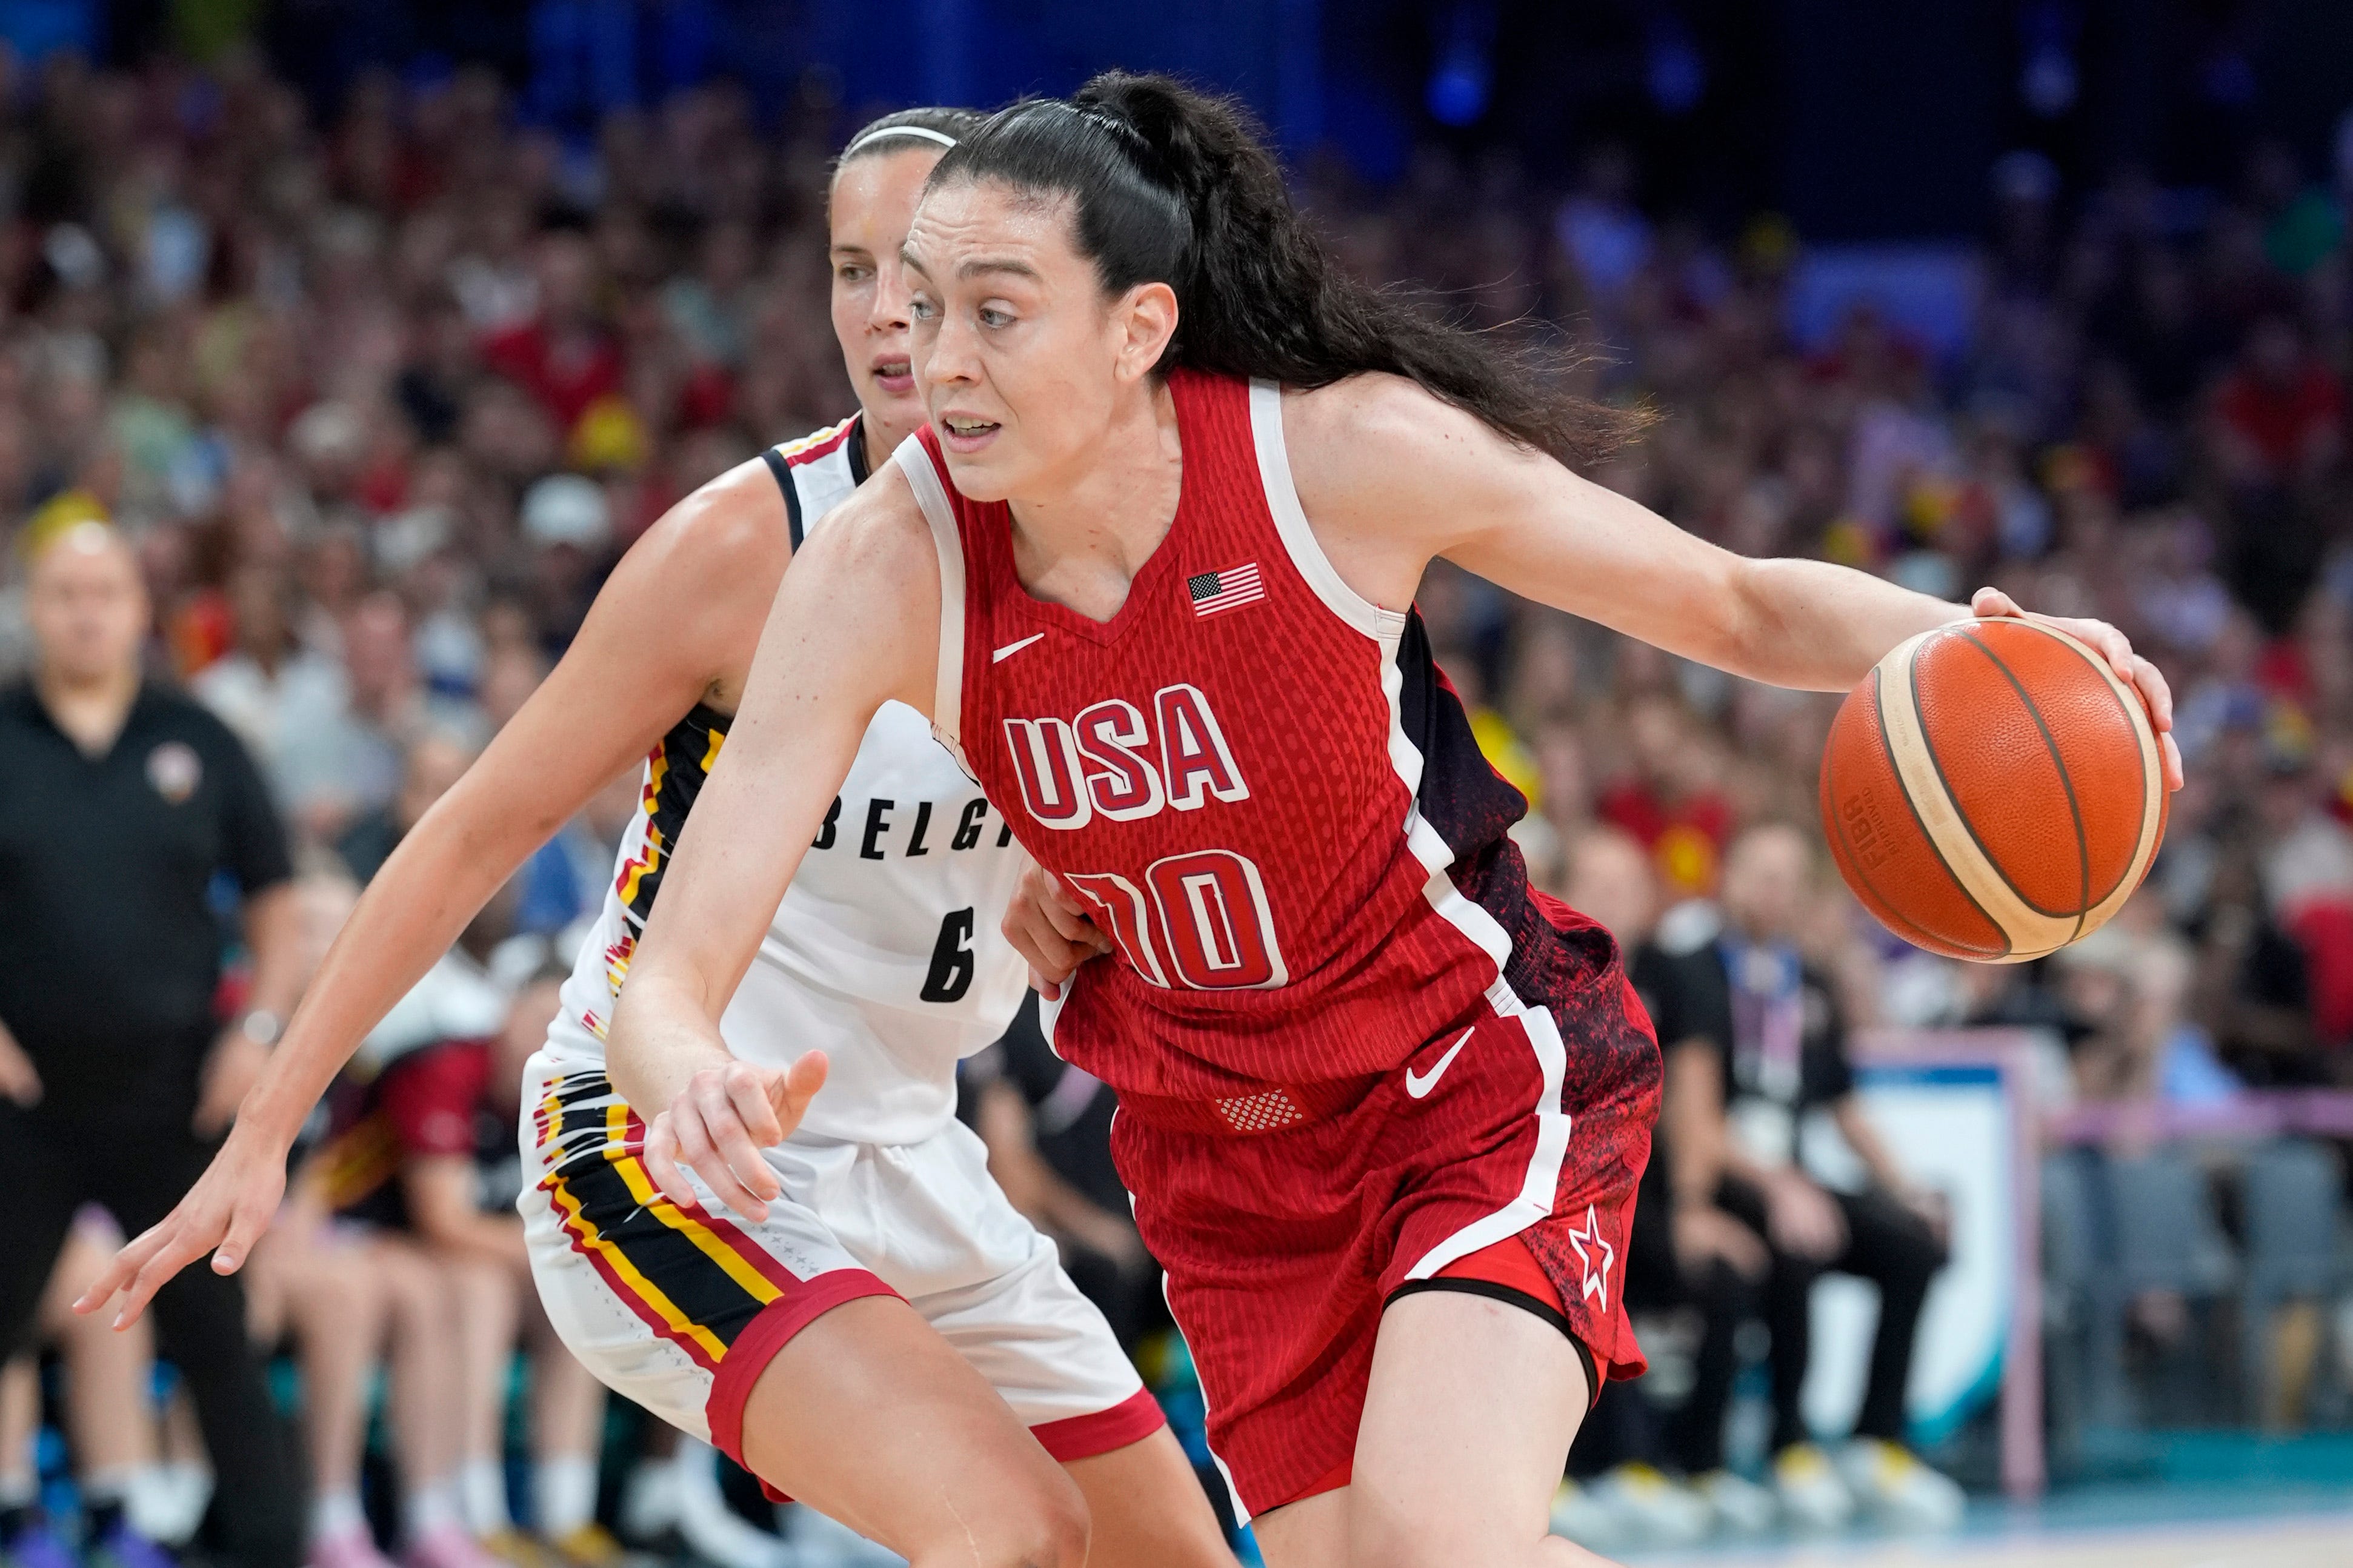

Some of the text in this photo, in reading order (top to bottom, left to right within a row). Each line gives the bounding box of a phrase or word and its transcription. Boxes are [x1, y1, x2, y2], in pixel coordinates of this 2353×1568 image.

[1003, 683, 1250, 830] USA
[1843, 794, 1888, 870] FIBA
[919, 906, 974, 1003] 6
[1063, 848, 1289, 991] 10
